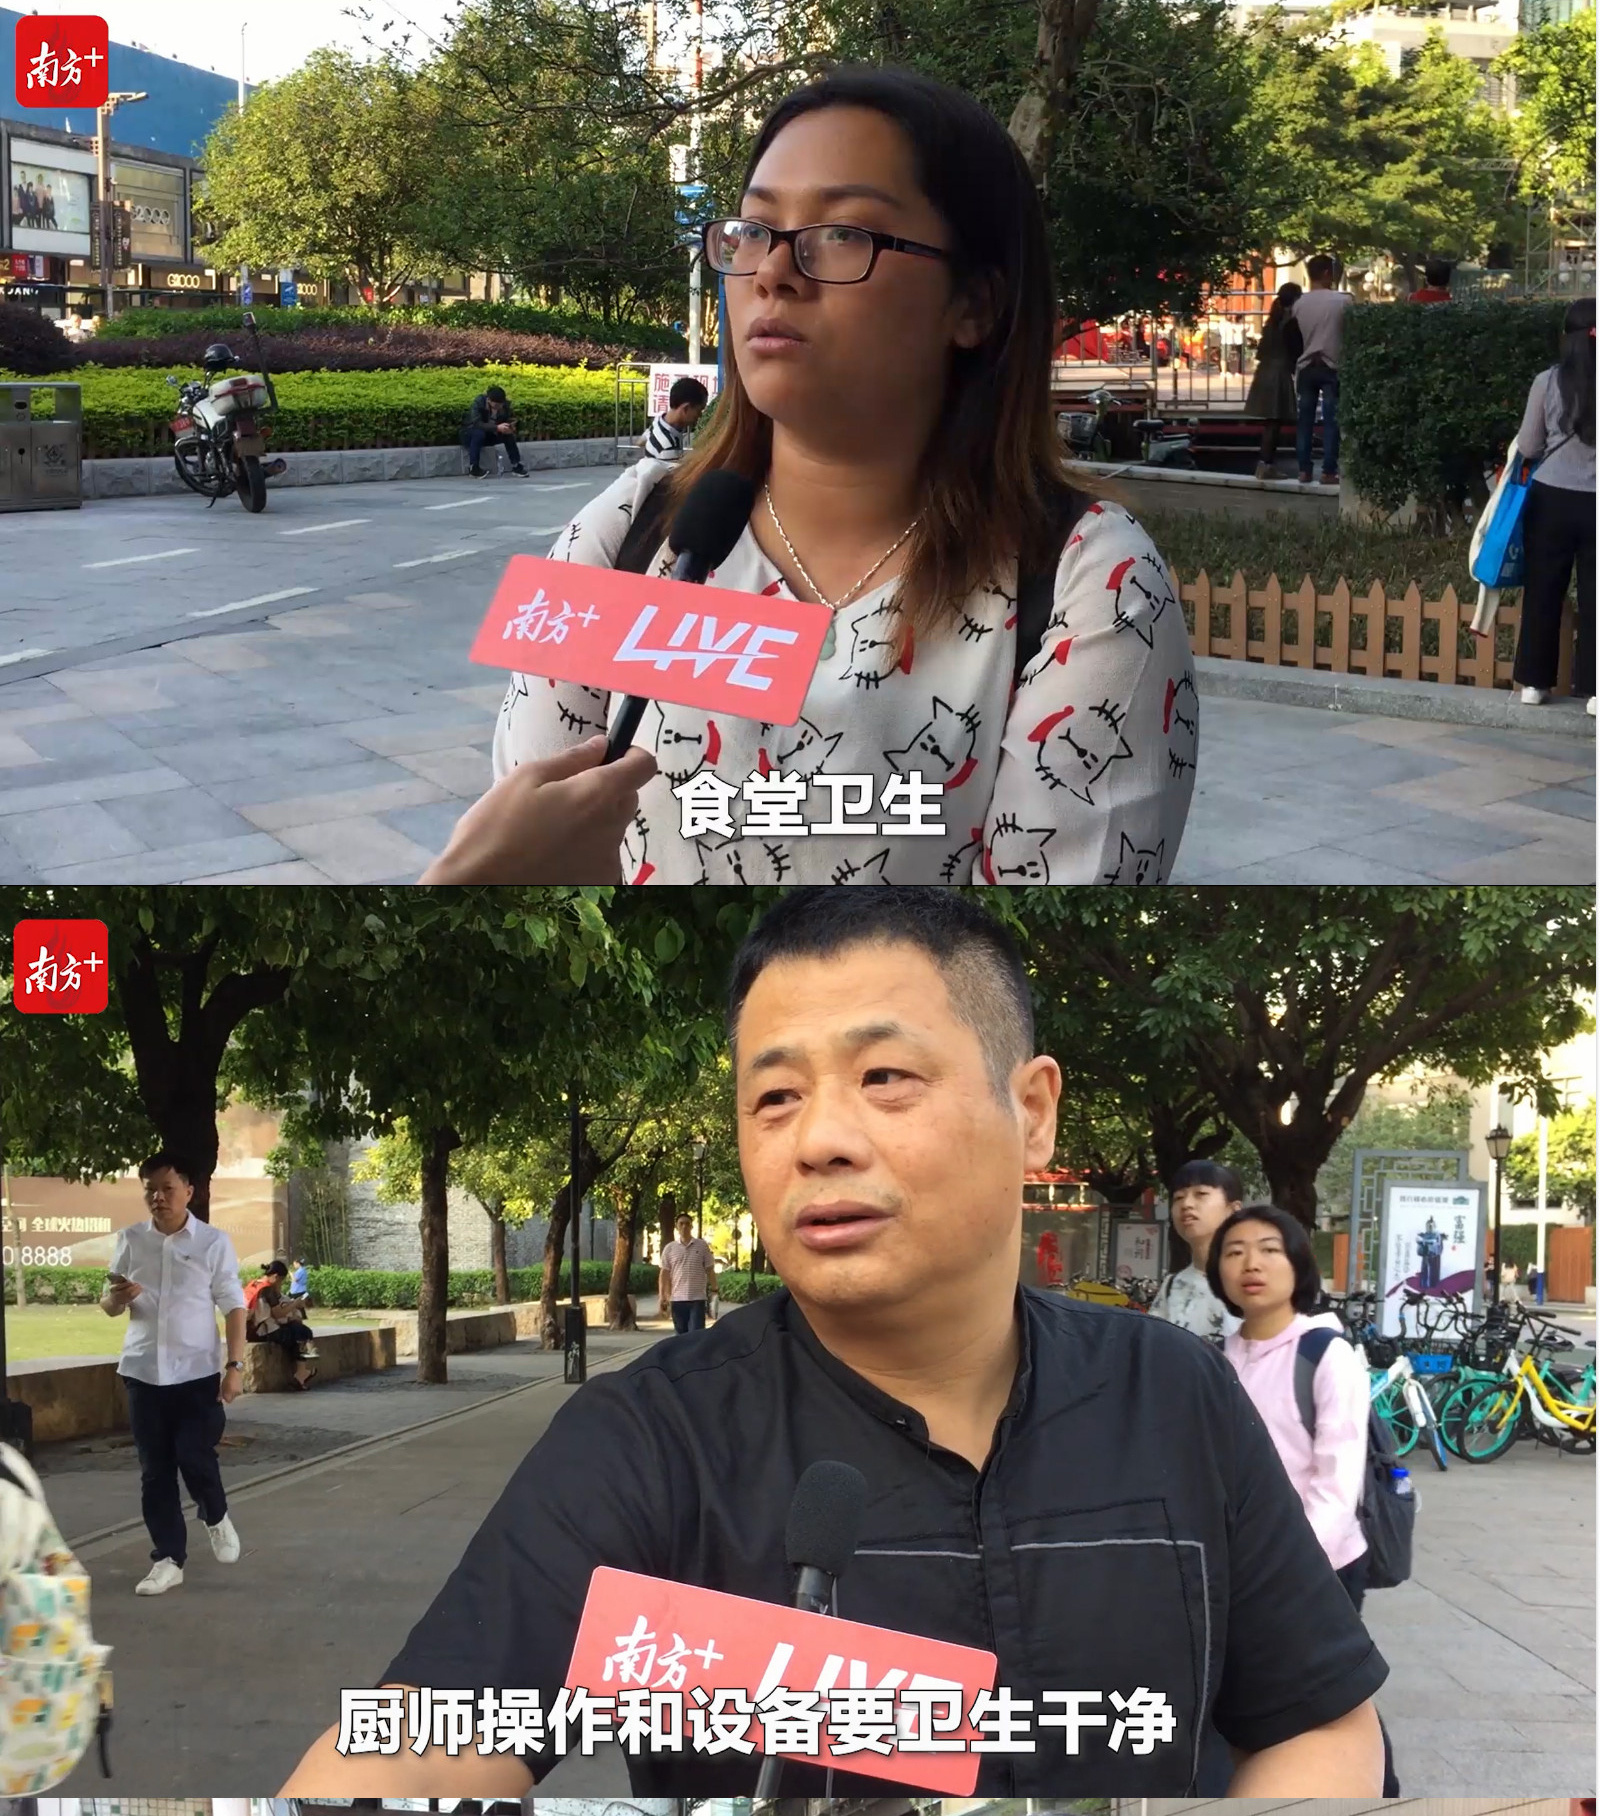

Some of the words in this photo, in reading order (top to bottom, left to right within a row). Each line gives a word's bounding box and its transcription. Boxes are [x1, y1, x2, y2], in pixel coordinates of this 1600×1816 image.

[502, 588, 601, 645] 南方+
[612, 604, 799, 692] LIVE
[21, 1246, 72, 1266] 8888
[602, 1615, 724, 1690] 南方+
